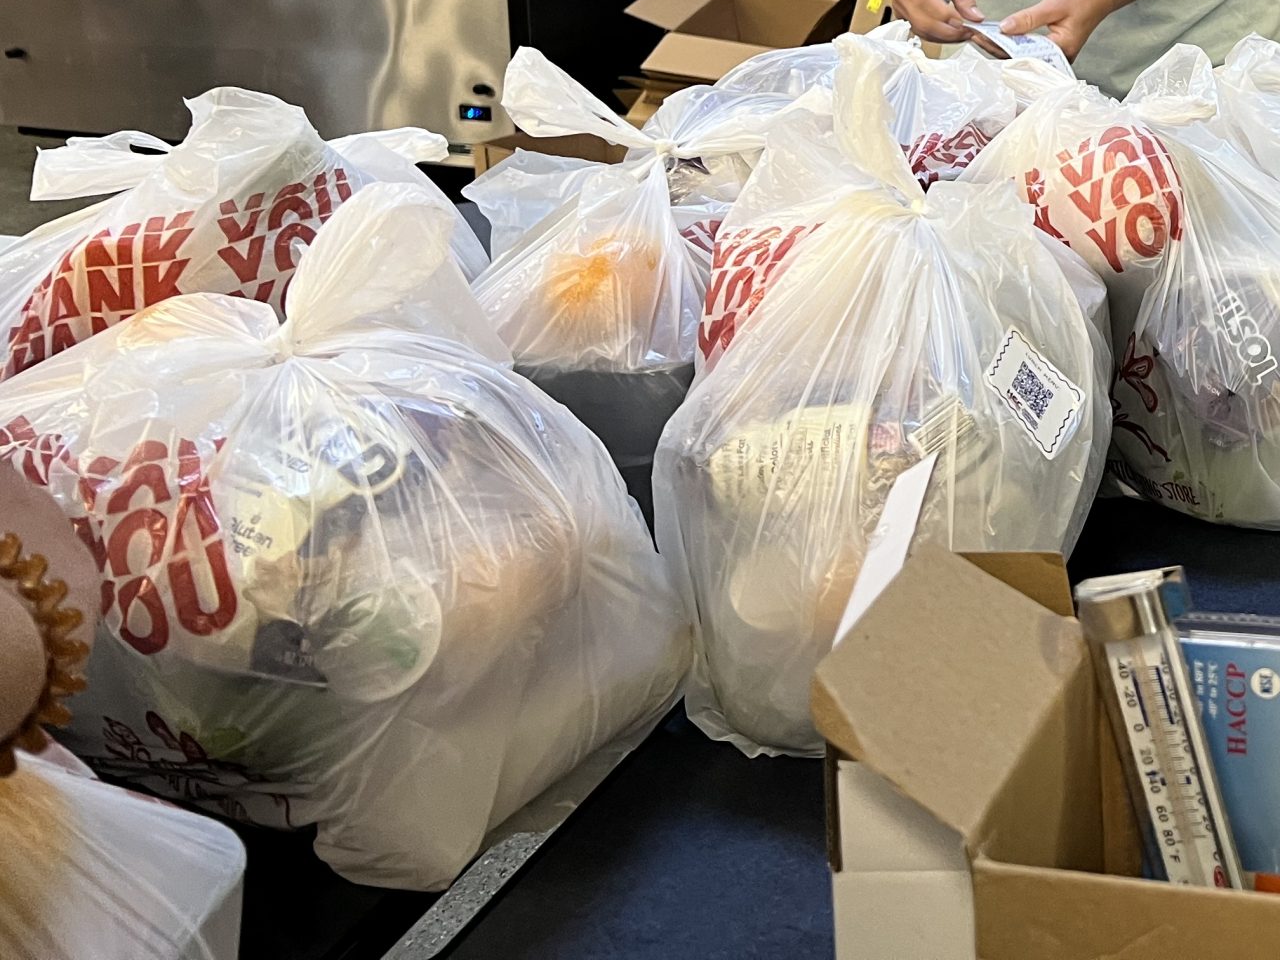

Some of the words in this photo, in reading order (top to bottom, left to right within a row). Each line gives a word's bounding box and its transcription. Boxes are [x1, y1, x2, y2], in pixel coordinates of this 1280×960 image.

[1226, 662, 1248, 757] HACCP
[1134, 723, 1144, 734] 0
[1155, 805, 1169, 823] 60
[1162, 829, 1176, 847] 80
